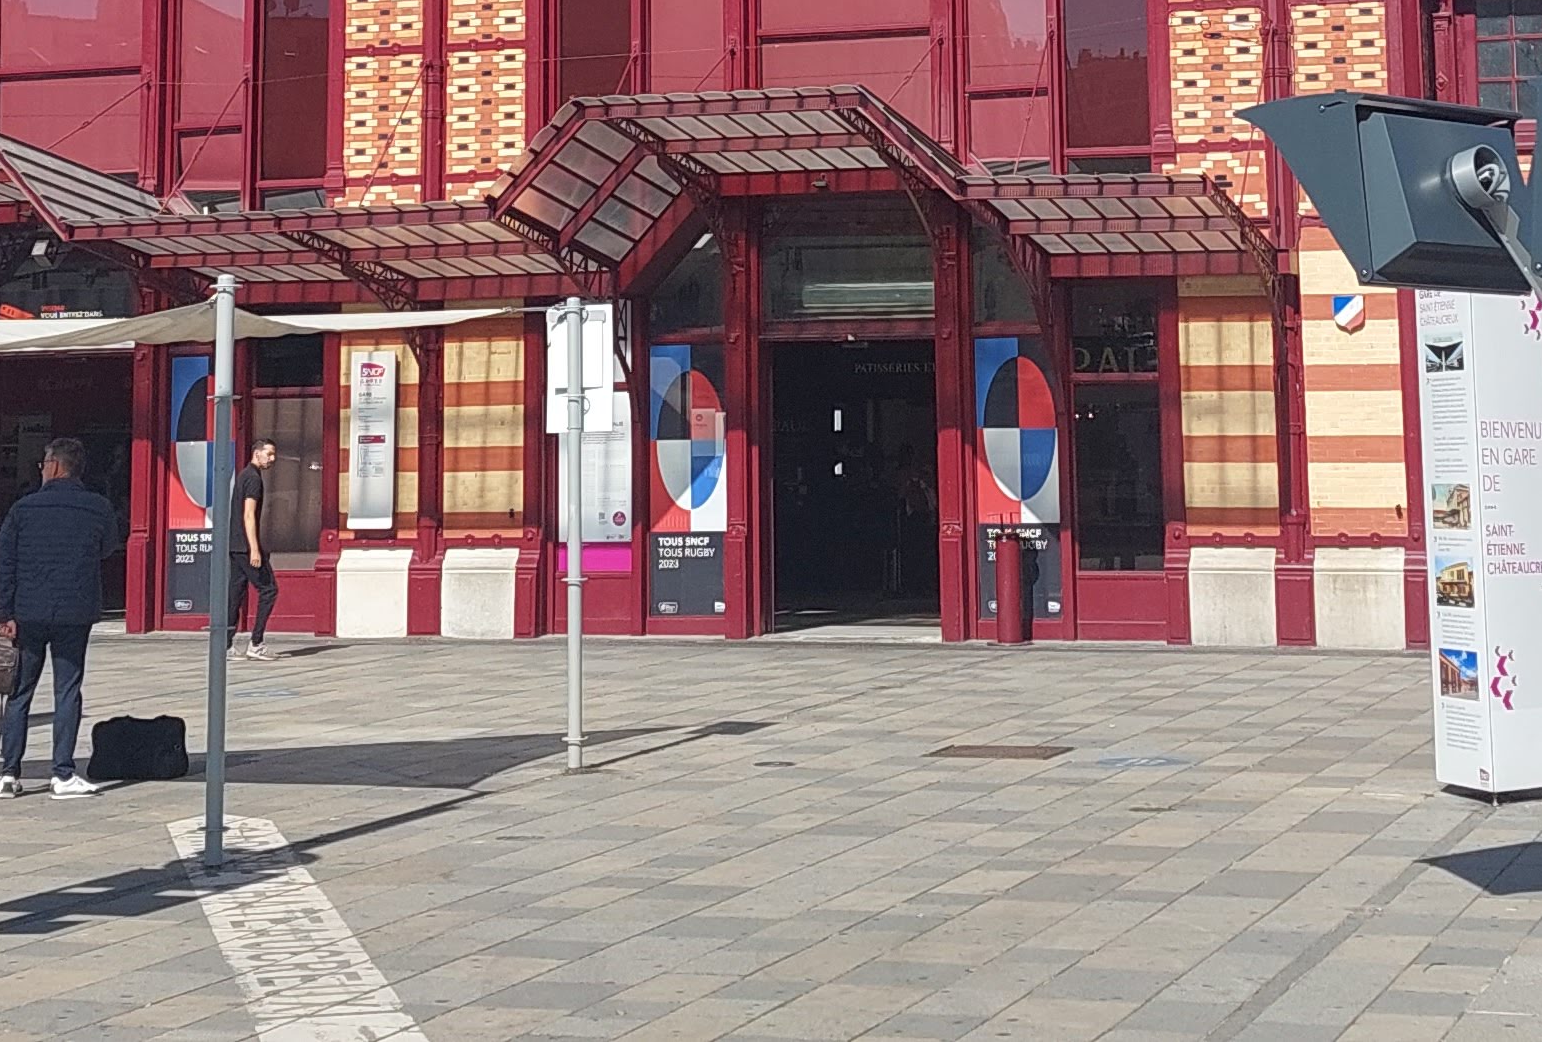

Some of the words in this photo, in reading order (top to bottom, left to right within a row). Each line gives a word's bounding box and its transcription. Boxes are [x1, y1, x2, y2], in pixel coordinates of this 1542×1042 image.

[1481, 447, 1500, 466] EN
[1503, 448, 1538, 466] GARE
[1482, 474, 1501, 492] DE
[1485, 524, 1515, 538] SAINT-
[175, 533, 199, 542] TOUS
[657, 536, 683, 546] TOUS
[684, 536, 710, 546] SNCF
[175, 544, 198, 553] TOUS
[657, 548, 683, 557] TOUS
[684, 547, 716, 557] RUGBY
[1486, 539, 1526, 556] ÉTIENNE
[175, 554, 195, 564] 2023
[658, 559, 679, 570] 2023
